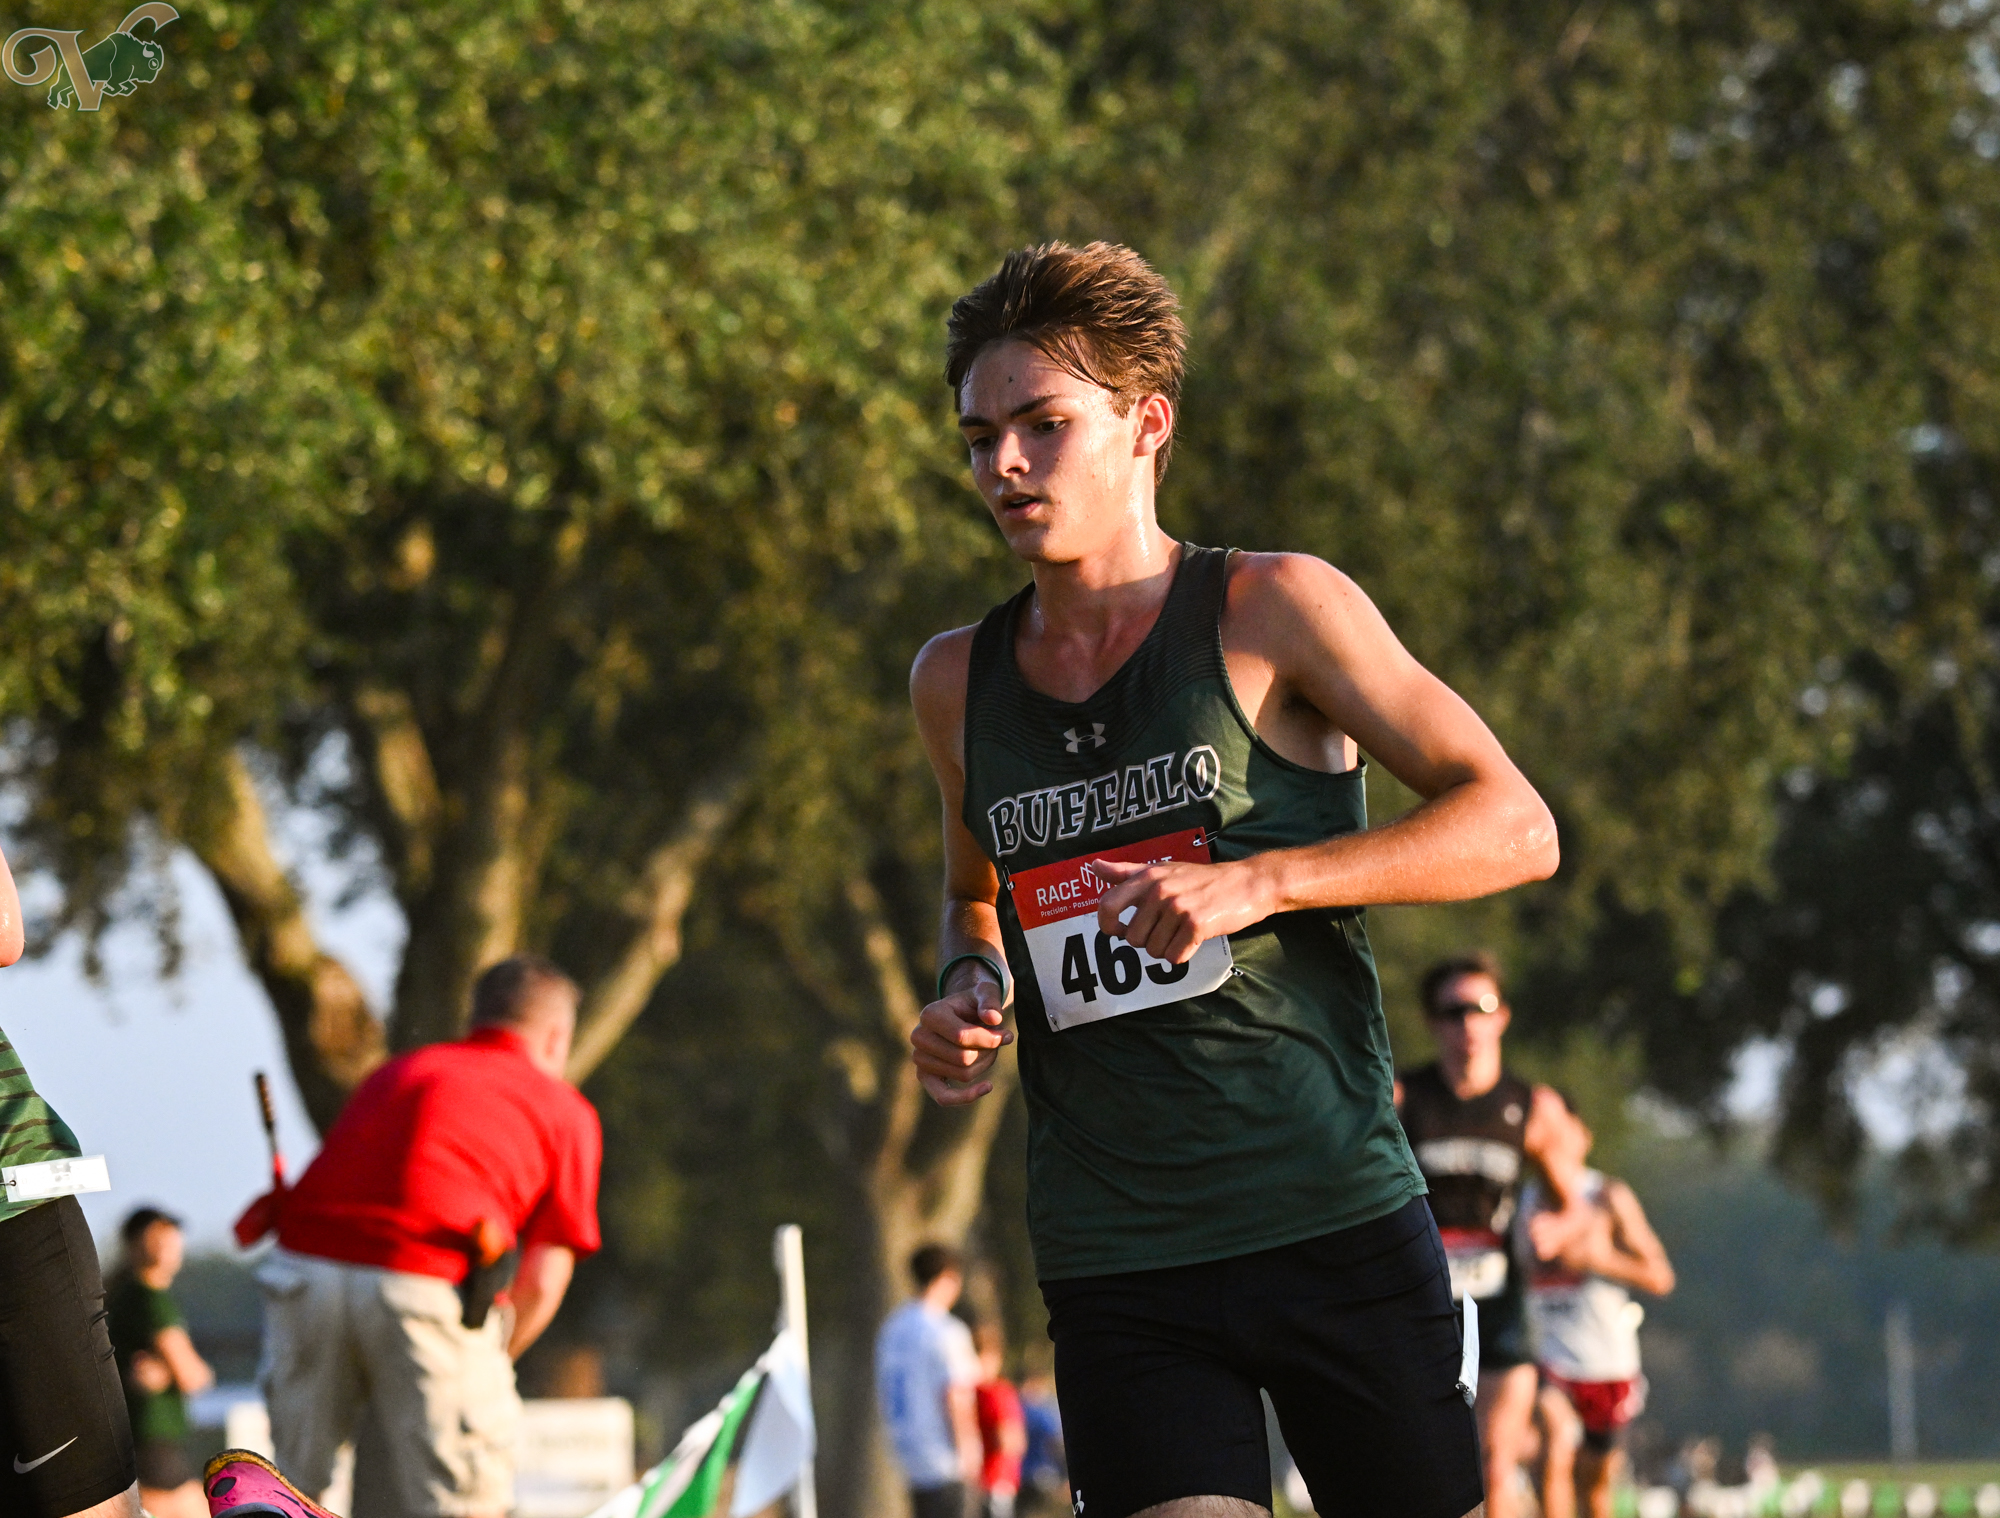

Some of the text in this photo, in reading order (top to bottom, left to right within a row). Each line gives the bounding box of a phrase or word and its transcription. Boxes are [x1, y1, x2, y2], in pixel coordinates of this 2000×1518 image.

[987, 744, 1221, 858] BUFFALO
[1036, 879, 1081, 907] RACE
[1040, 898, 1099, 918] Precision Passion
